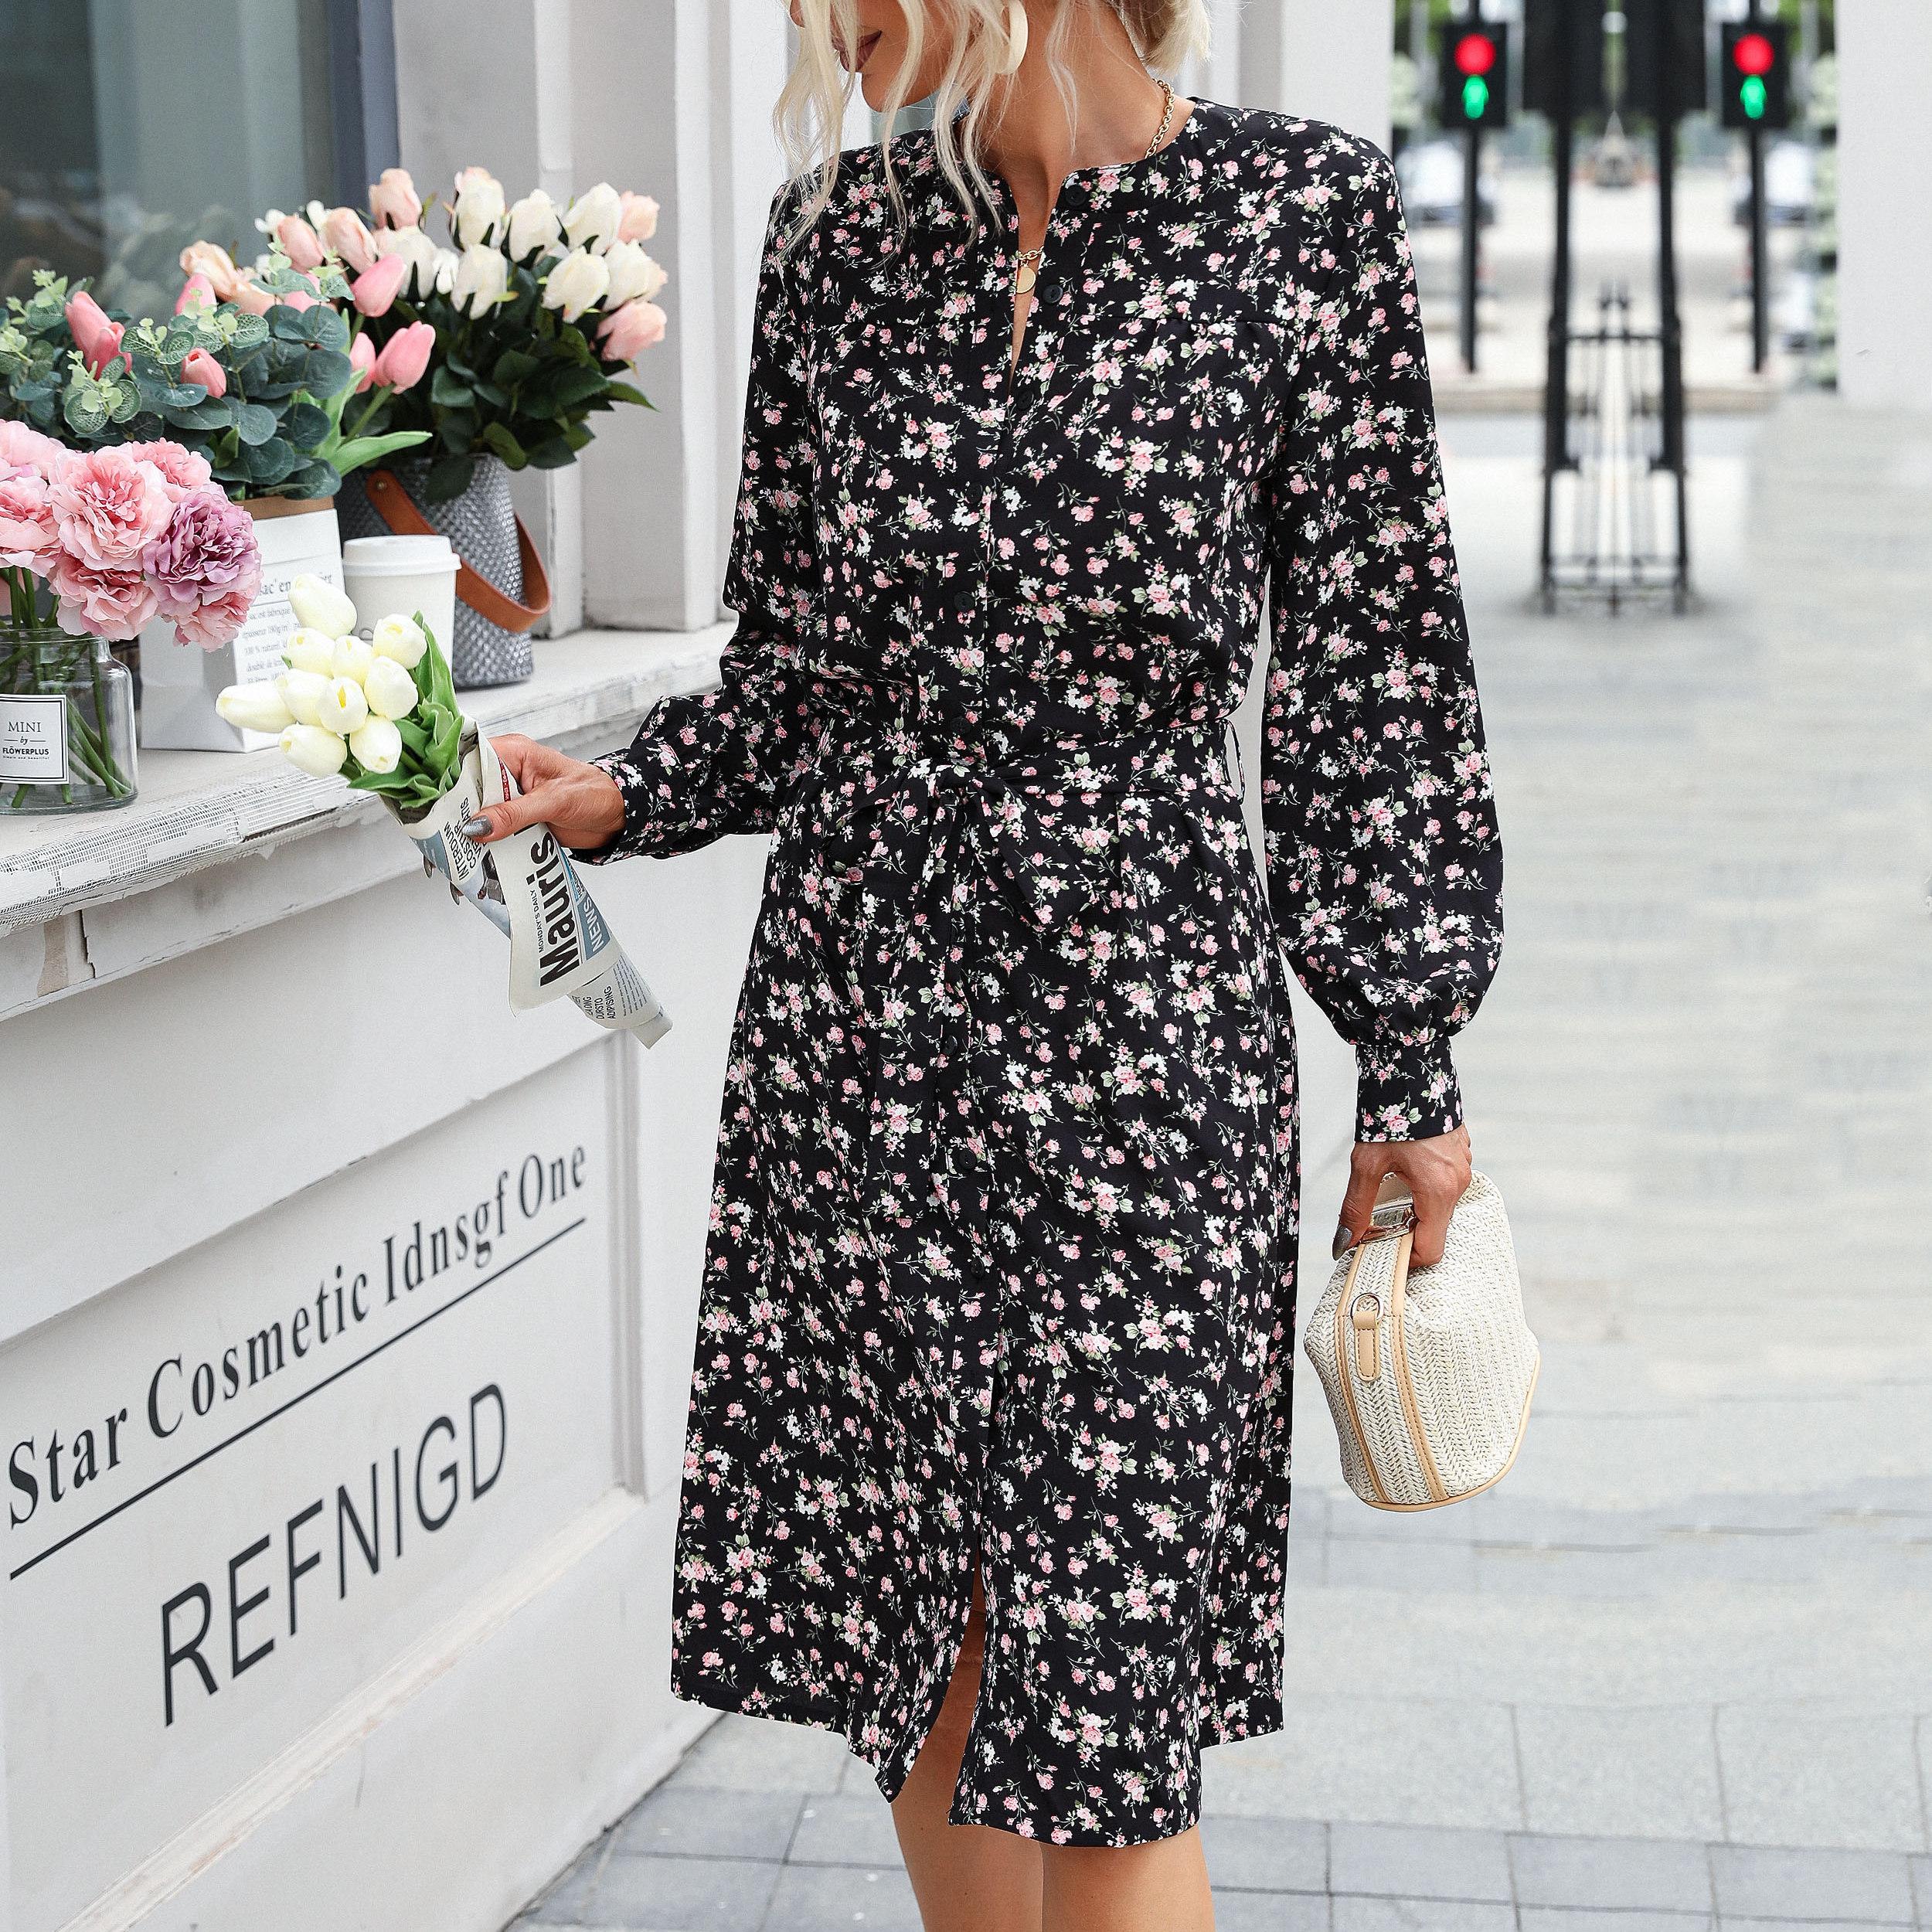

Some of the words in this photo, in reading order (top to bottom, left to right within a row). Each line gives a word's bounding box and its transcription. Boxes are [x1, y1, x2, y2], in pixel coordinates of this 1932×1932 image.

[8, 721, 42, 733] MINI
[20, 736, 28, 745] by
[444, 821, 470, 881] INTERDUM
[526, 831, 580, 987] Mauris
[530, 889, 539, 913] DAILY
[583, 896, 604, 952] NEWS
[535, 913, 544, 953] MONDAY'S
[8, 1406, 128, 1531] Star
[147, 1265, 371, 1440] Cosmetic
[518, 1144, 587, 1219] One
[161, 1383, 508, 1728] REFNIGD
